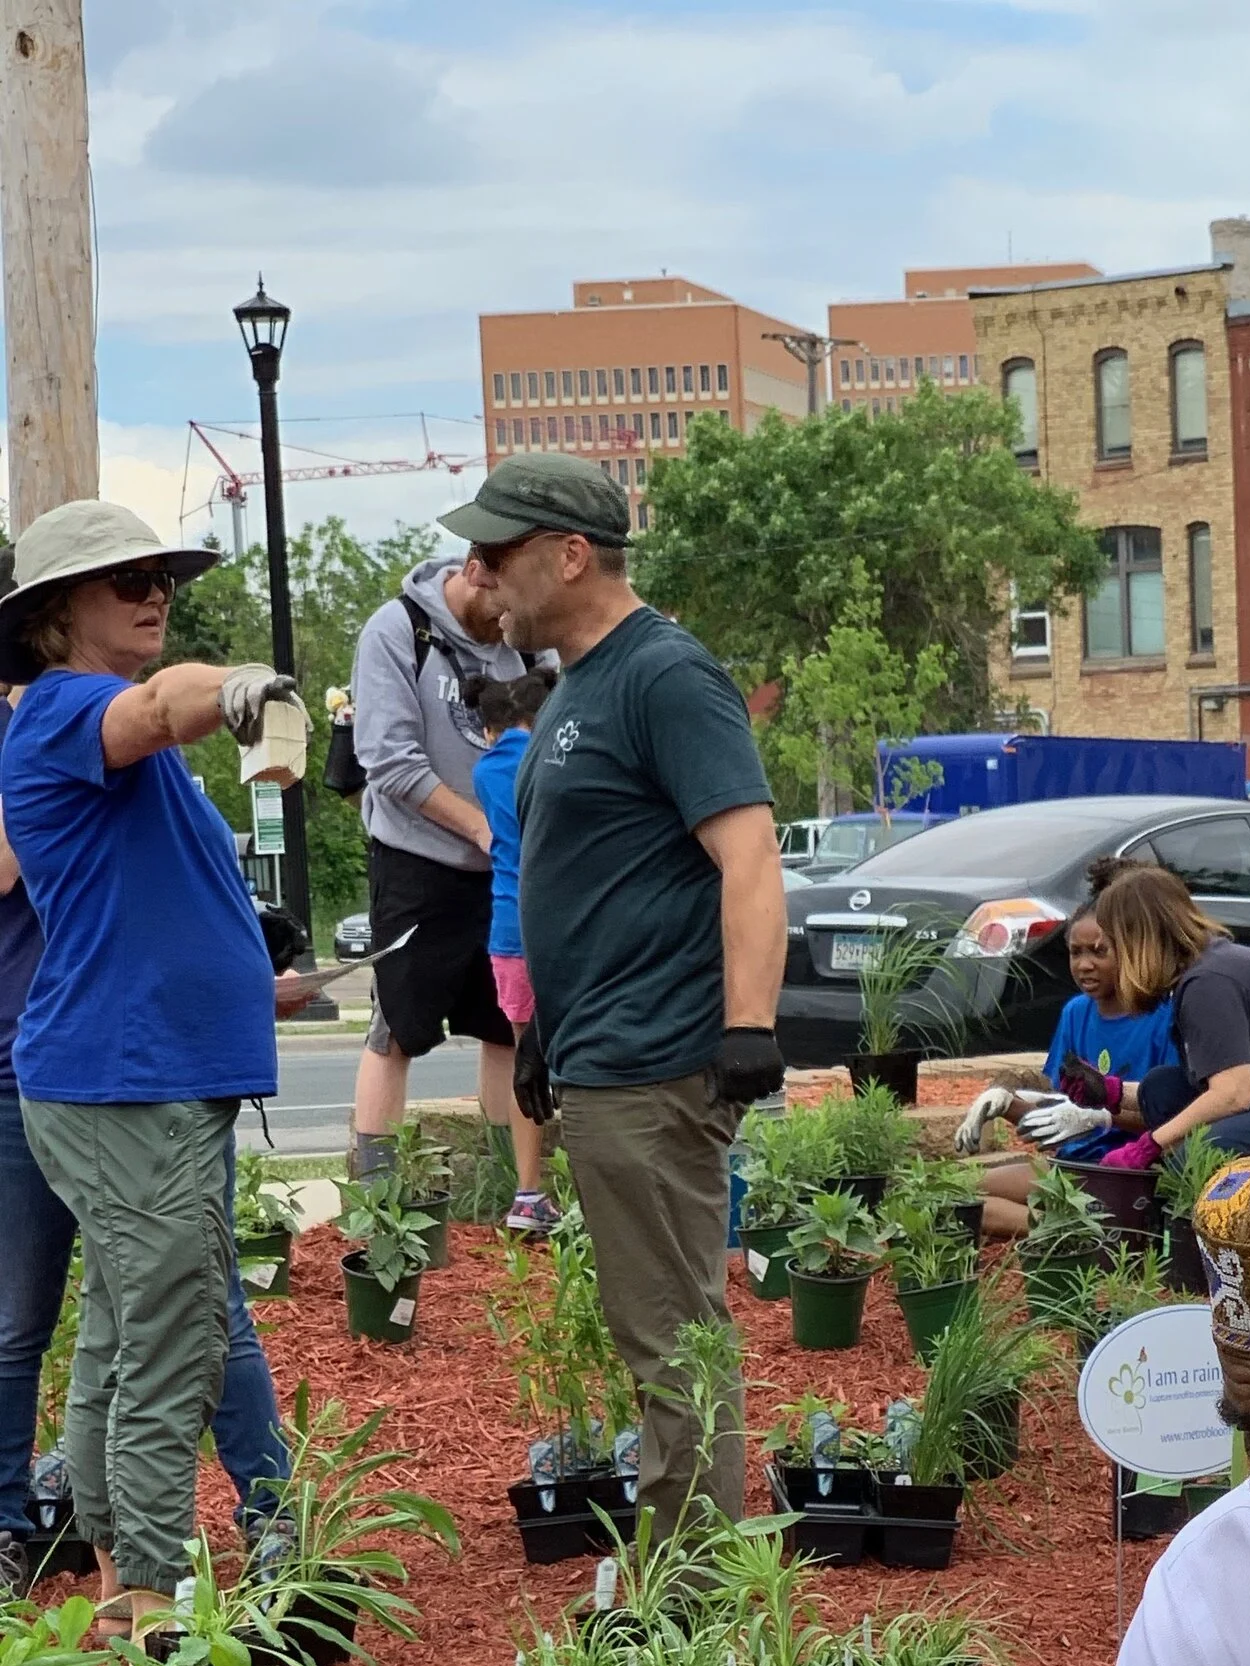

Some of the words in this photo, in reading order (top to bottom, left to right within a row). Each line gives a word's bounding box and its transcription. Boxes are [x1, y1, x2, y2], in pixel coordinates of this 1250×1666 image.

[1148, 1368, 1151, 1387] I
[1155, 1371, 1177, 1387] am
[1181, 1370, 1189, 1384] a
[1193, 1361, 1220, 1383] rain
